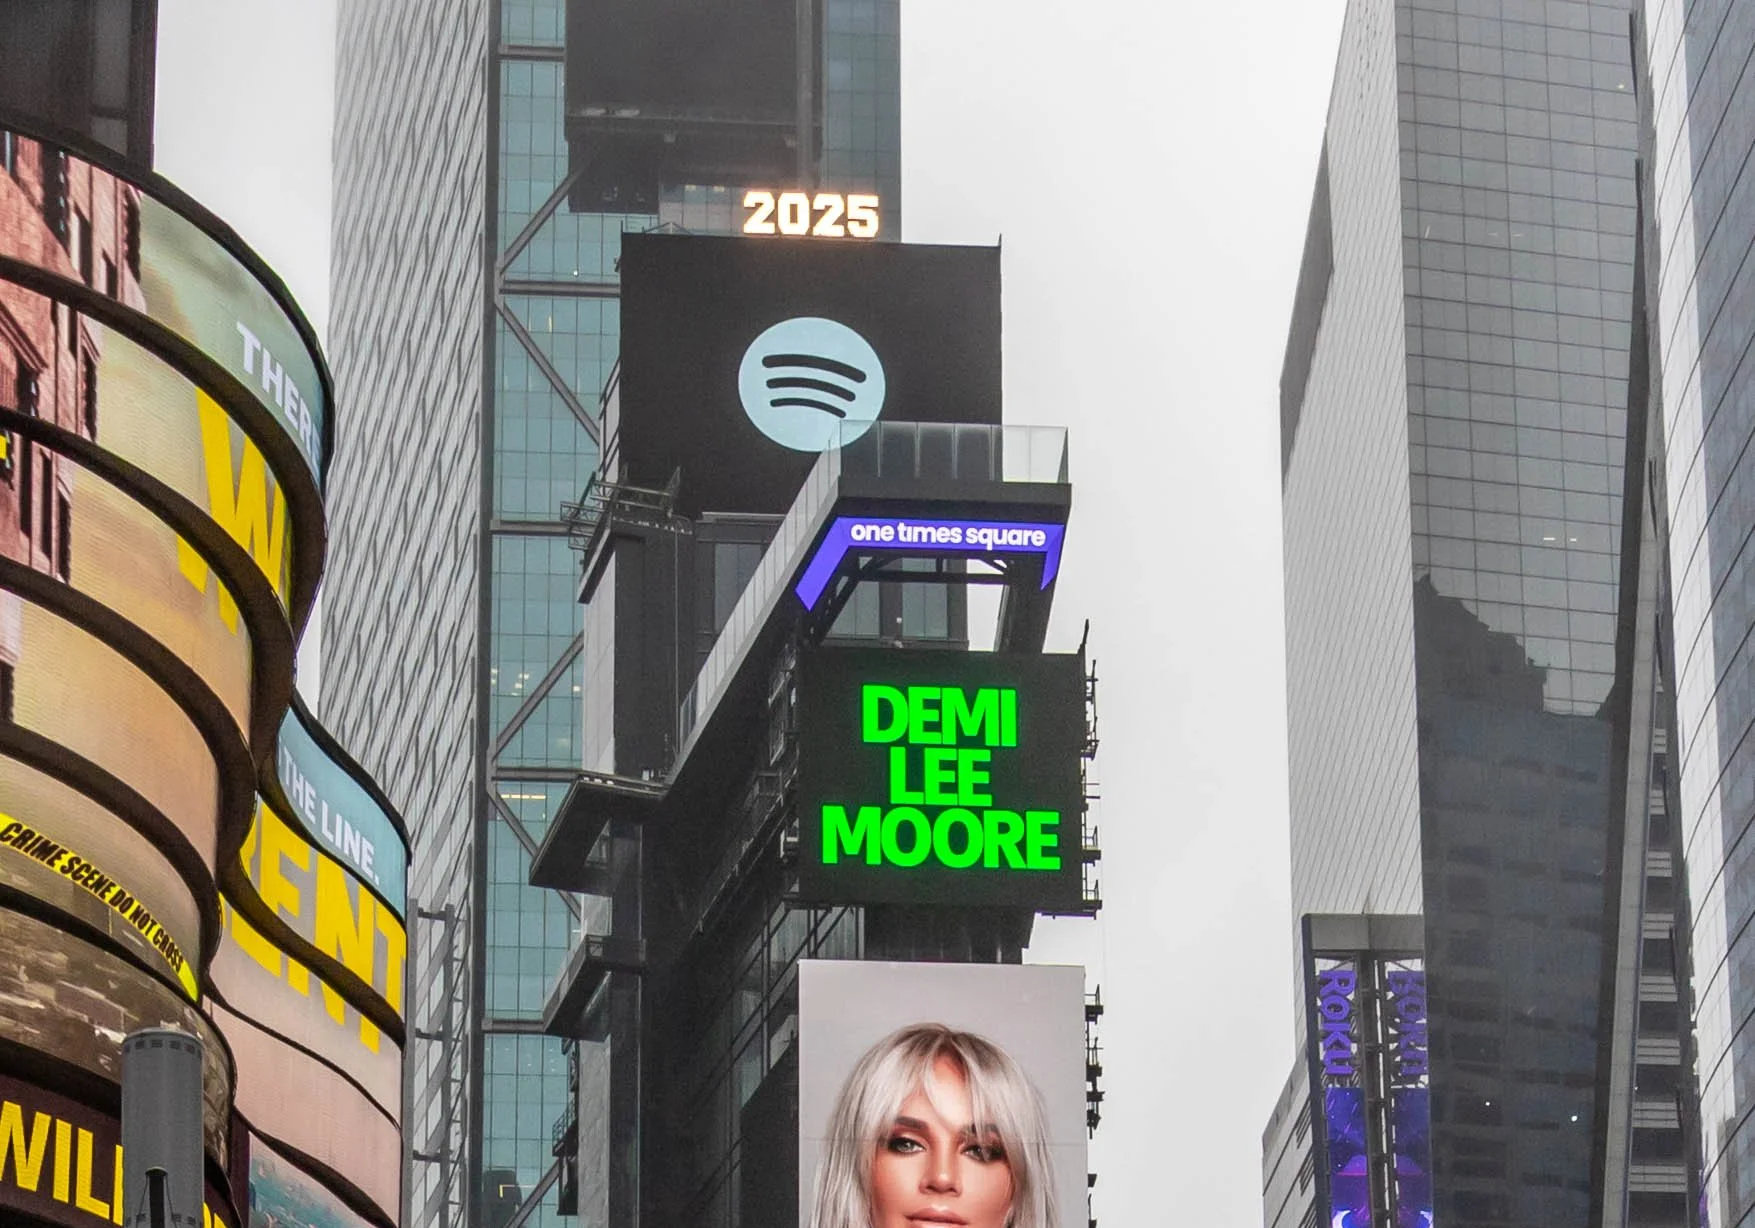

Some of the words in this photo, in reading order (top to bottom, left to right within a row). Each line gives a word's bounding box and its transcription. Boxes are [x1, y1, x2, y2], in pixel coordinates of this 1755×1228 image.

[743, 191, 879, 238] 2025
[851, 524, 895, 542] one
[897, 522, 963, 544] times
[966, 527, 1046, 550] square
[862, 684, 1016, 746] DEMI
[889, 747, 993, 806] LEE
[283, 748, 316, 824] THE
[321, 801, 381, 885] LINE.
[822, 806, 1061, 870] MOORE
[0, 822, 69, 868] CRIME
[60, 856, 117, 902] SCENE
[108, 889, 135, 915] DO
[128, 904, 158, 936] NOT
[152, 928, 184, 973] CROSS
